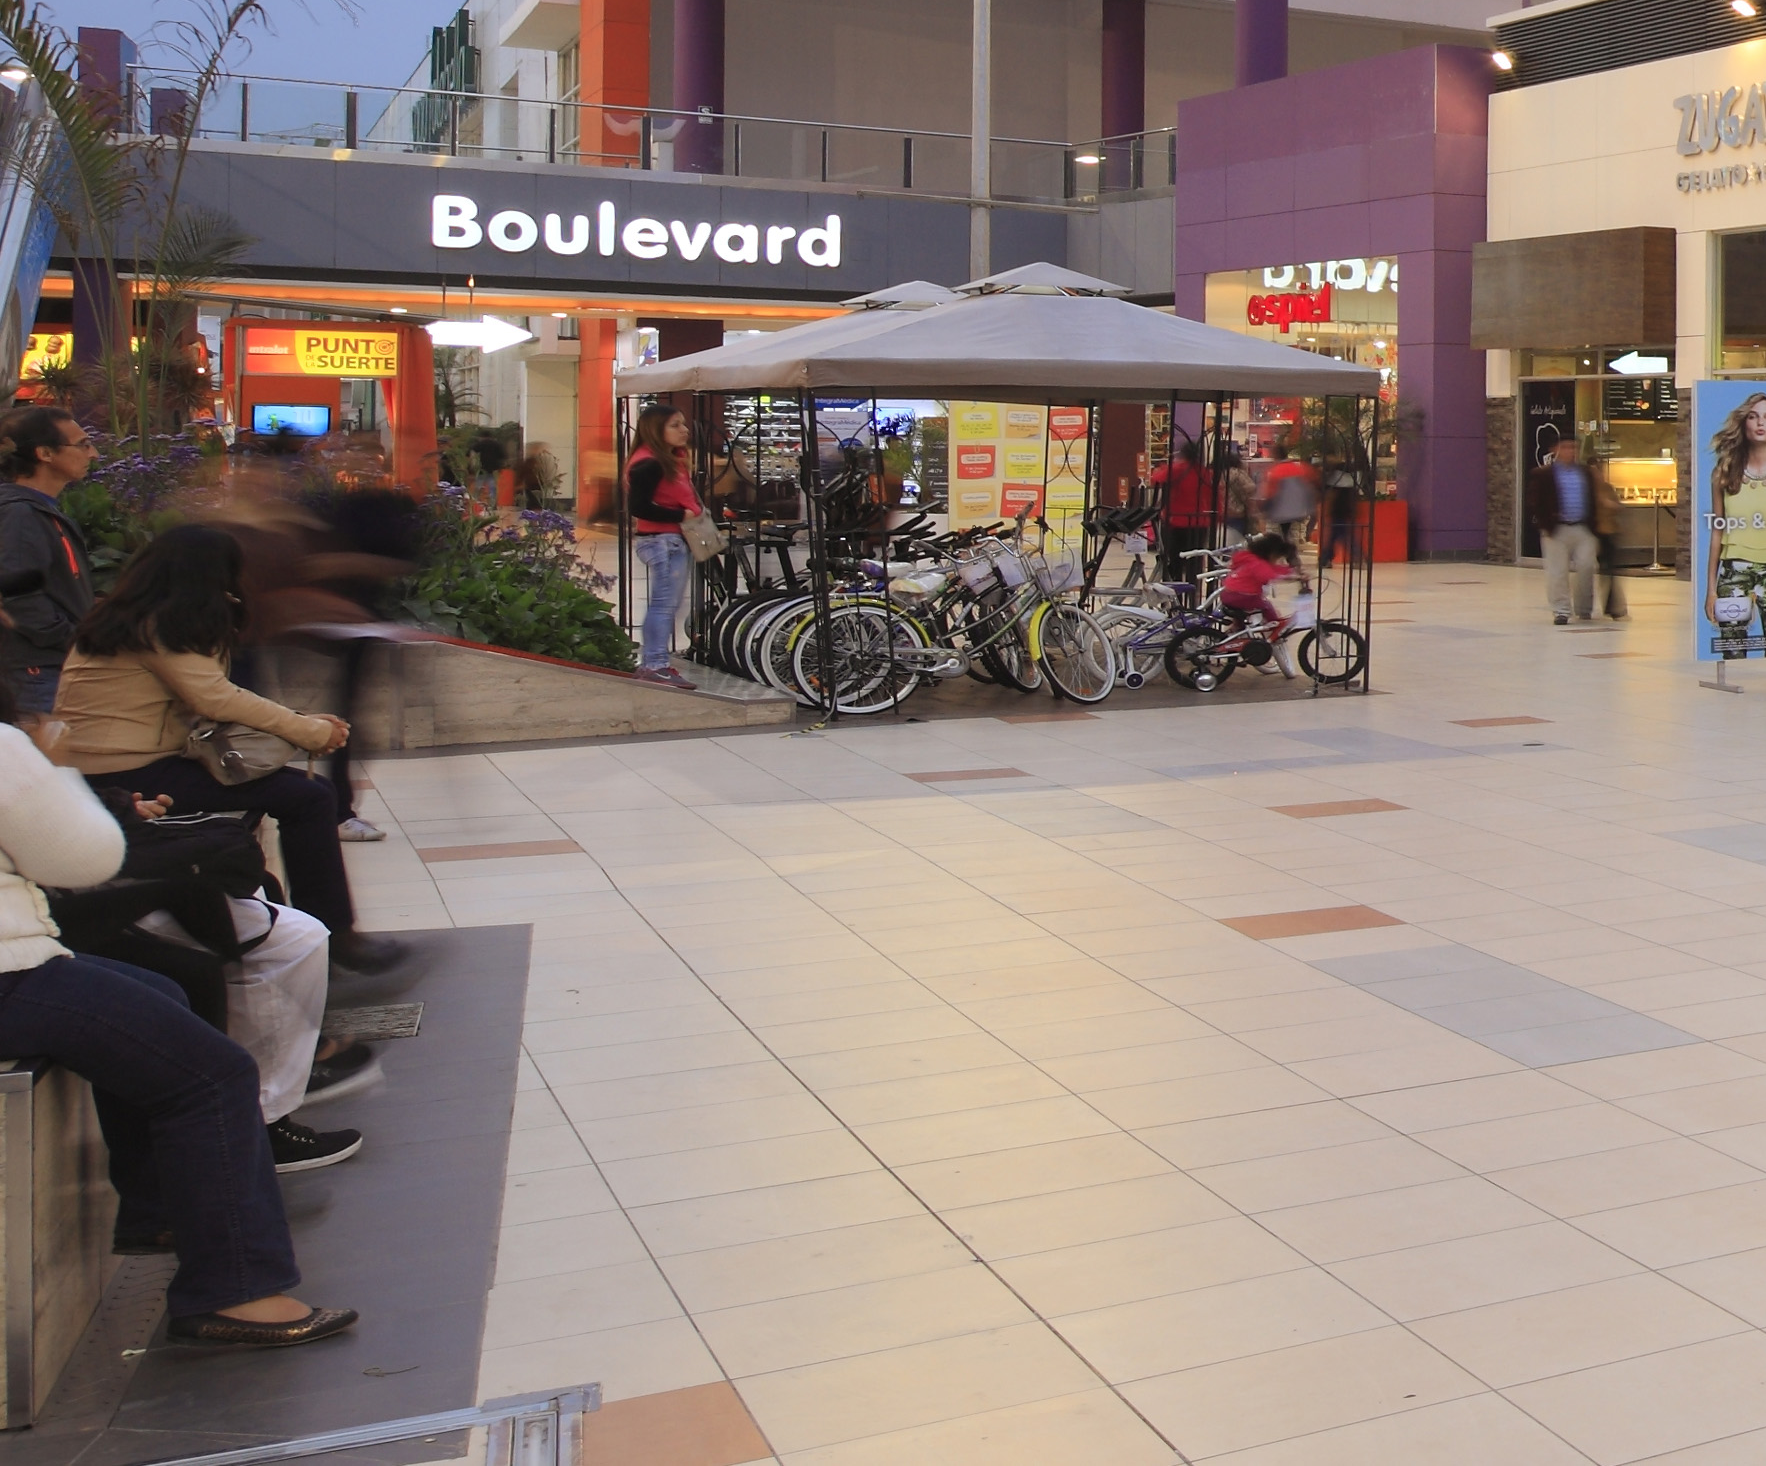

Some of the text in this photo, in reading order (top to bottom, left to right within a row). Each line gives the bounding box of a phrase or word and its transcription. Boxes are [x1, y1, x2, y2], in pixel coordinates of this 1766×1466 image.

[1676, 164, 1748, 193] GELATO
[431, 194, 841, 268] Boulevard
[317, 355, 396, 370] SUERTE
[1704, 513, 1746, 533] Tops
[1752, 512, 1766, 529] &
